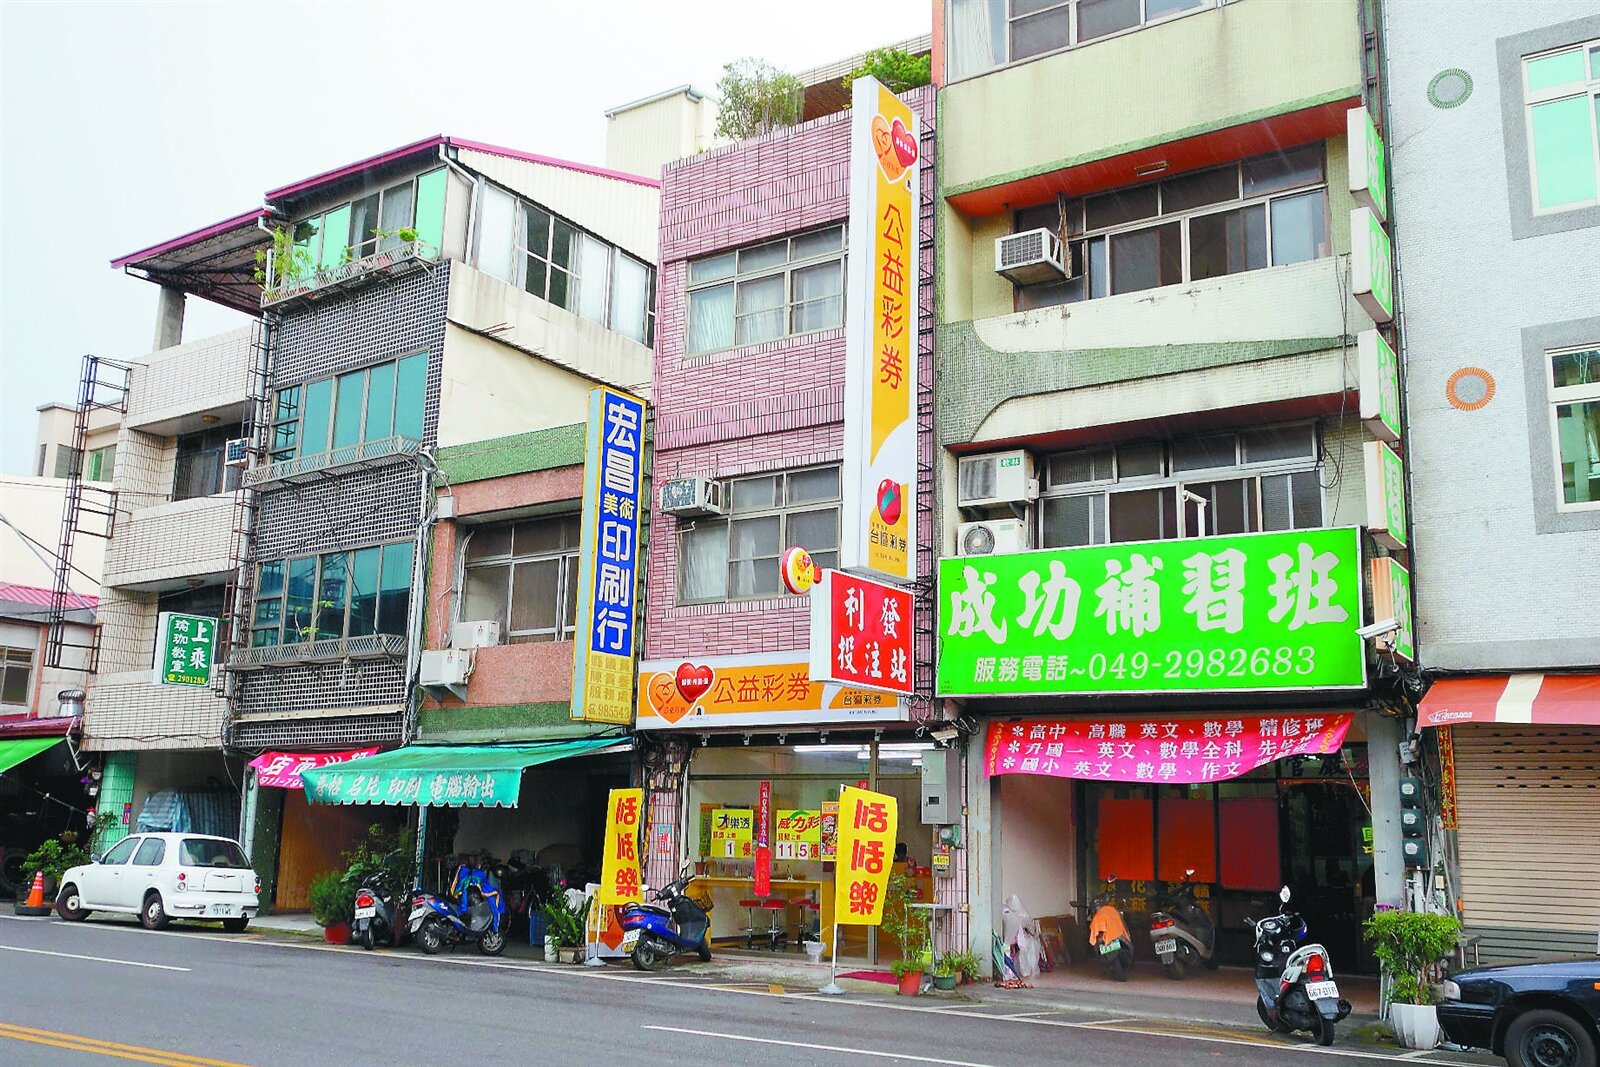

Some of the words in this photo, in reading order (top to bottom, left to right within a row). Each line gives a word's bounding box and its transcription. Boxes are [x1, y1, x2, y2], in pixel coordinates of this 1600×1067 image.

[878, 203, 904, 390] 公益彩券
[605, 403, 637, 494] 宏昌
[603, 491, 635, 520] 美術
[597, 521, 631, 650] 印刷行
[946, 543, 1350, 645] 成功補習班
[170, 619, 190, 673] 瑜珈教室
[190, 621, 209, 670] 上乘
[837, 634, 907, 683] 投注站
[713, 672, 811, 705] 公益彩券
[1140, 720, 1244, 740] 英文、數學
[1259, 717, 1325, 737] 精修班
[1025, 742, 1085, 757] 升國一
[1097, 740, 1244, 760] 英文、數學全科
[1019, 757, 1061, 774] 國小
[346, 774, 381, 797] 名片
[387, 775, 423, 799] 印刷
[429, 774, 496, 799] 電腦輸出
[717, 813, 751, 832] 大樂透
[777, 815, 820, 834] 威力彩
[727, 842, 733, 855] 1
[742, 841, 752, 856] 億
[778, 843, 808, 858] 11.5
[810, 843, 819, 858] 億
